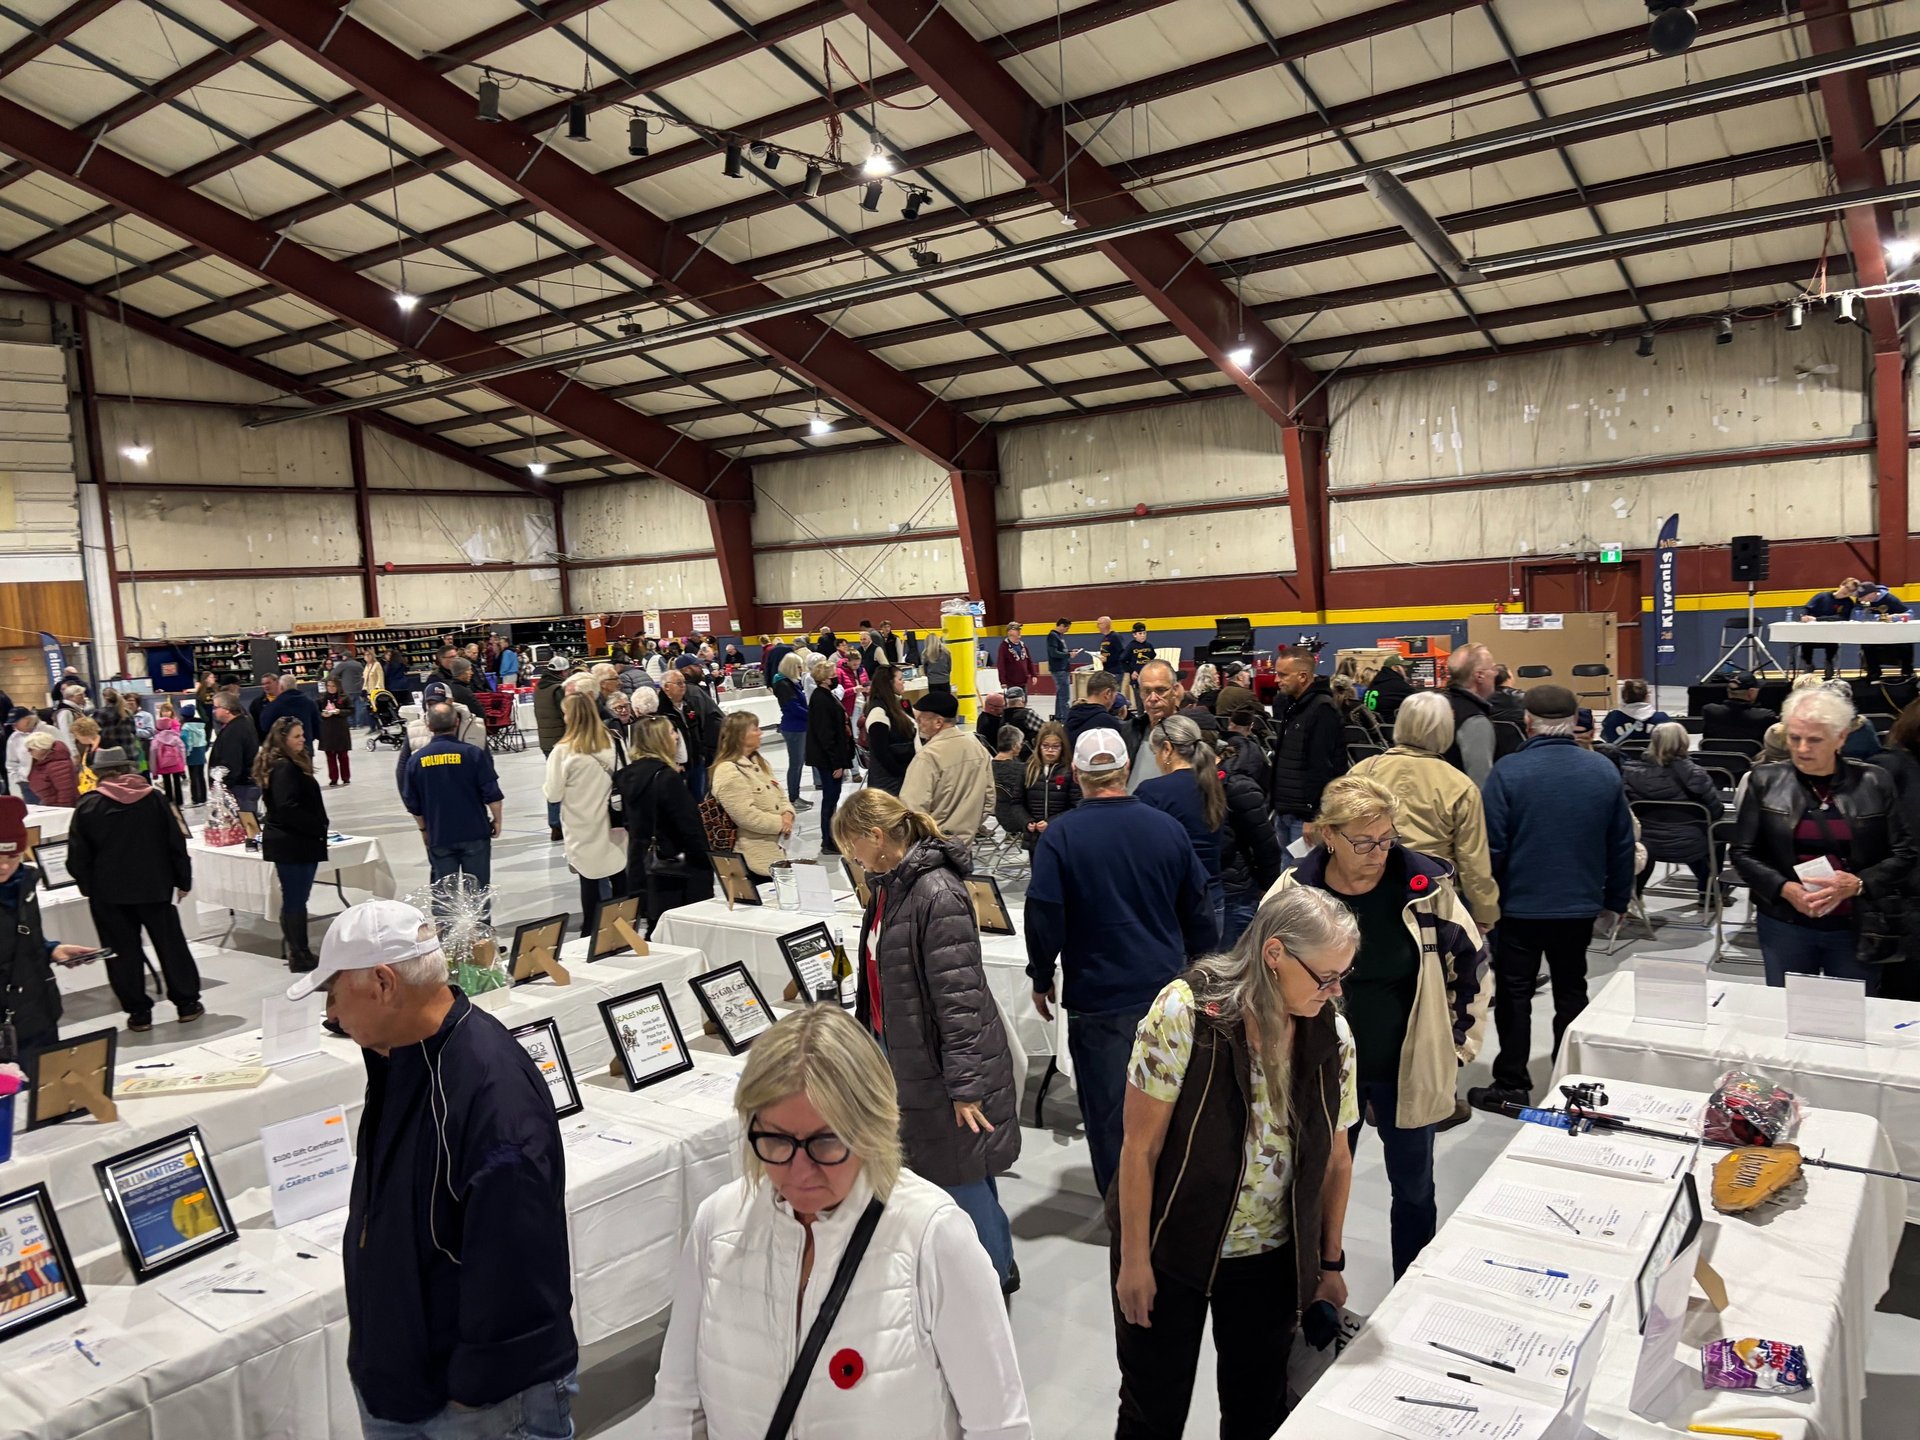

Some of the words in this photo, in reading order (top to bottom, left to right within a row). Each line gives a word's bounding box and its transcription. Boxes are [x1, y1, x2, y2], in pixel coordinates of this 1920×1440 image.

[1660, 552, 1674, 628] Kiwanis
[420, 753, 462, 768] VOLUNTEER
[719, 986, 733, 997] Gift
[636, 1003, 661, 1017] NATURE
[292, 1147, 307, 1158] Gift
[307, 1137, 345, 1153] Certificate
[285, 1173, 317, 1189] CARPET
[318, 1167, 335, 1179] ONE
[20, 1224, 39, 1235] Gift
[23, 1233, 46, 1246] Card
